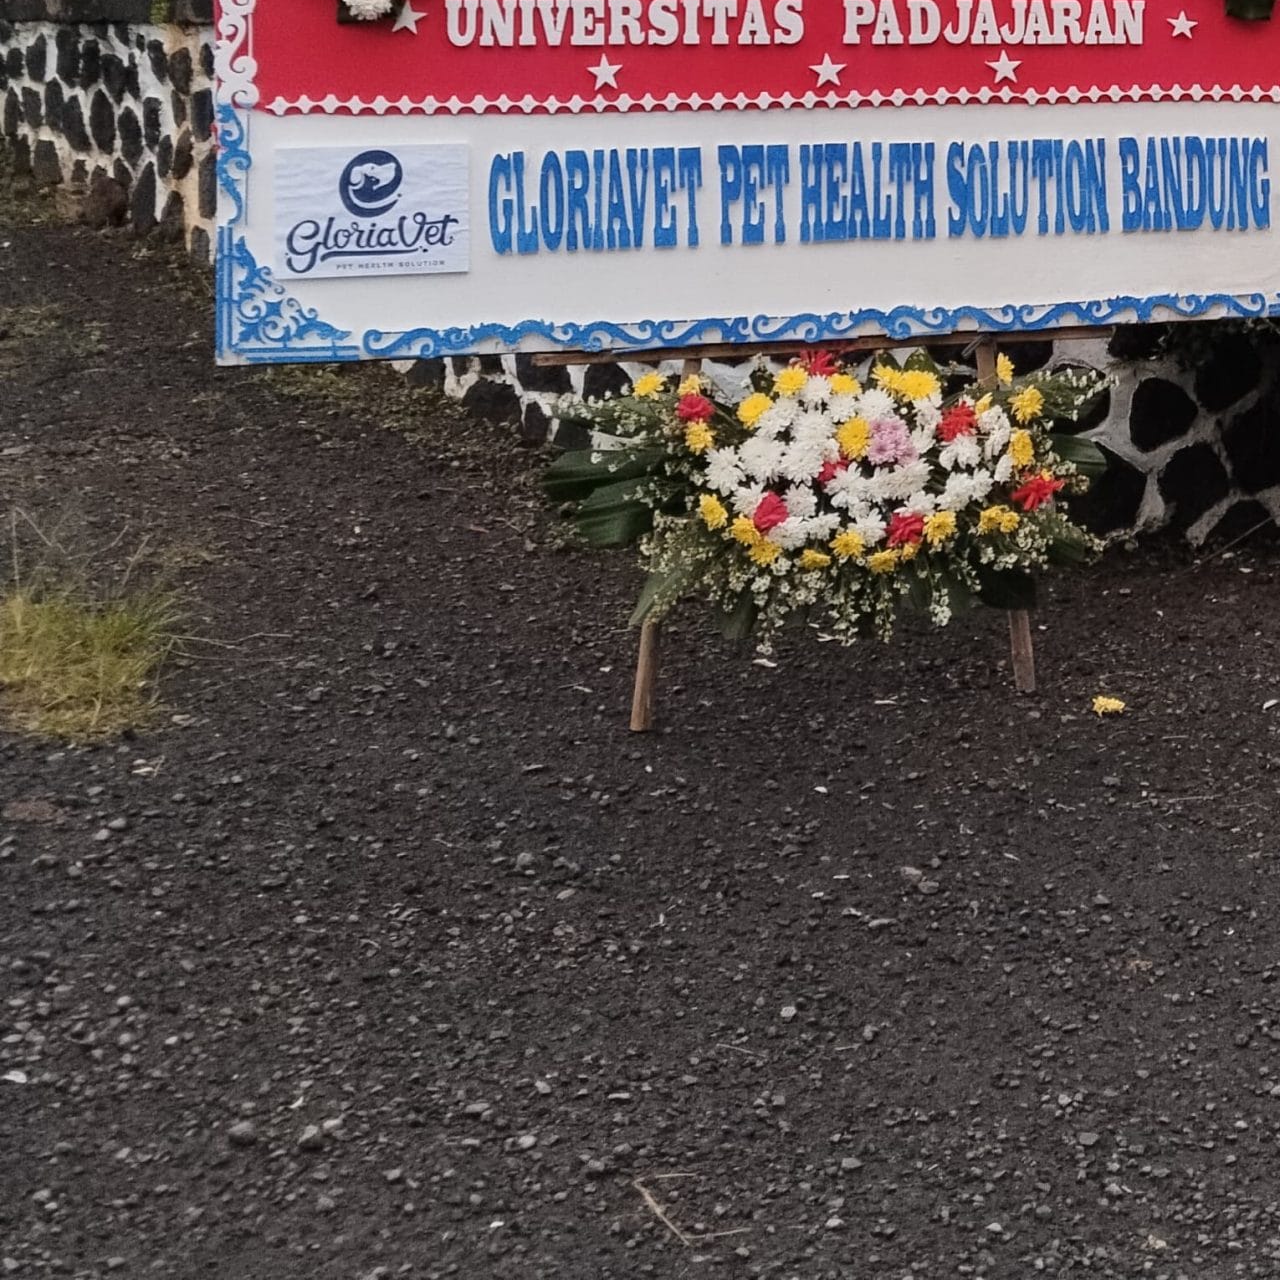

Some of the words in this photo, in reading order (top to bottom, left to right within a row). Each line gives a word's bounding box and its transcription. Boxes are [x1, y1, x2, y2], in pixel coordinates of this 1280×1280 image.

[488, 147, 702, 255] GLORIAVET
[717, 144, 789, 245] PET
[800, 141, 936, 244] HEALTH
[948, 138, 1107, 237] SOLUTION
[1119, 135, 1271, 232] BANDUNG
[286, 212, 459, 274] GloriaVet
